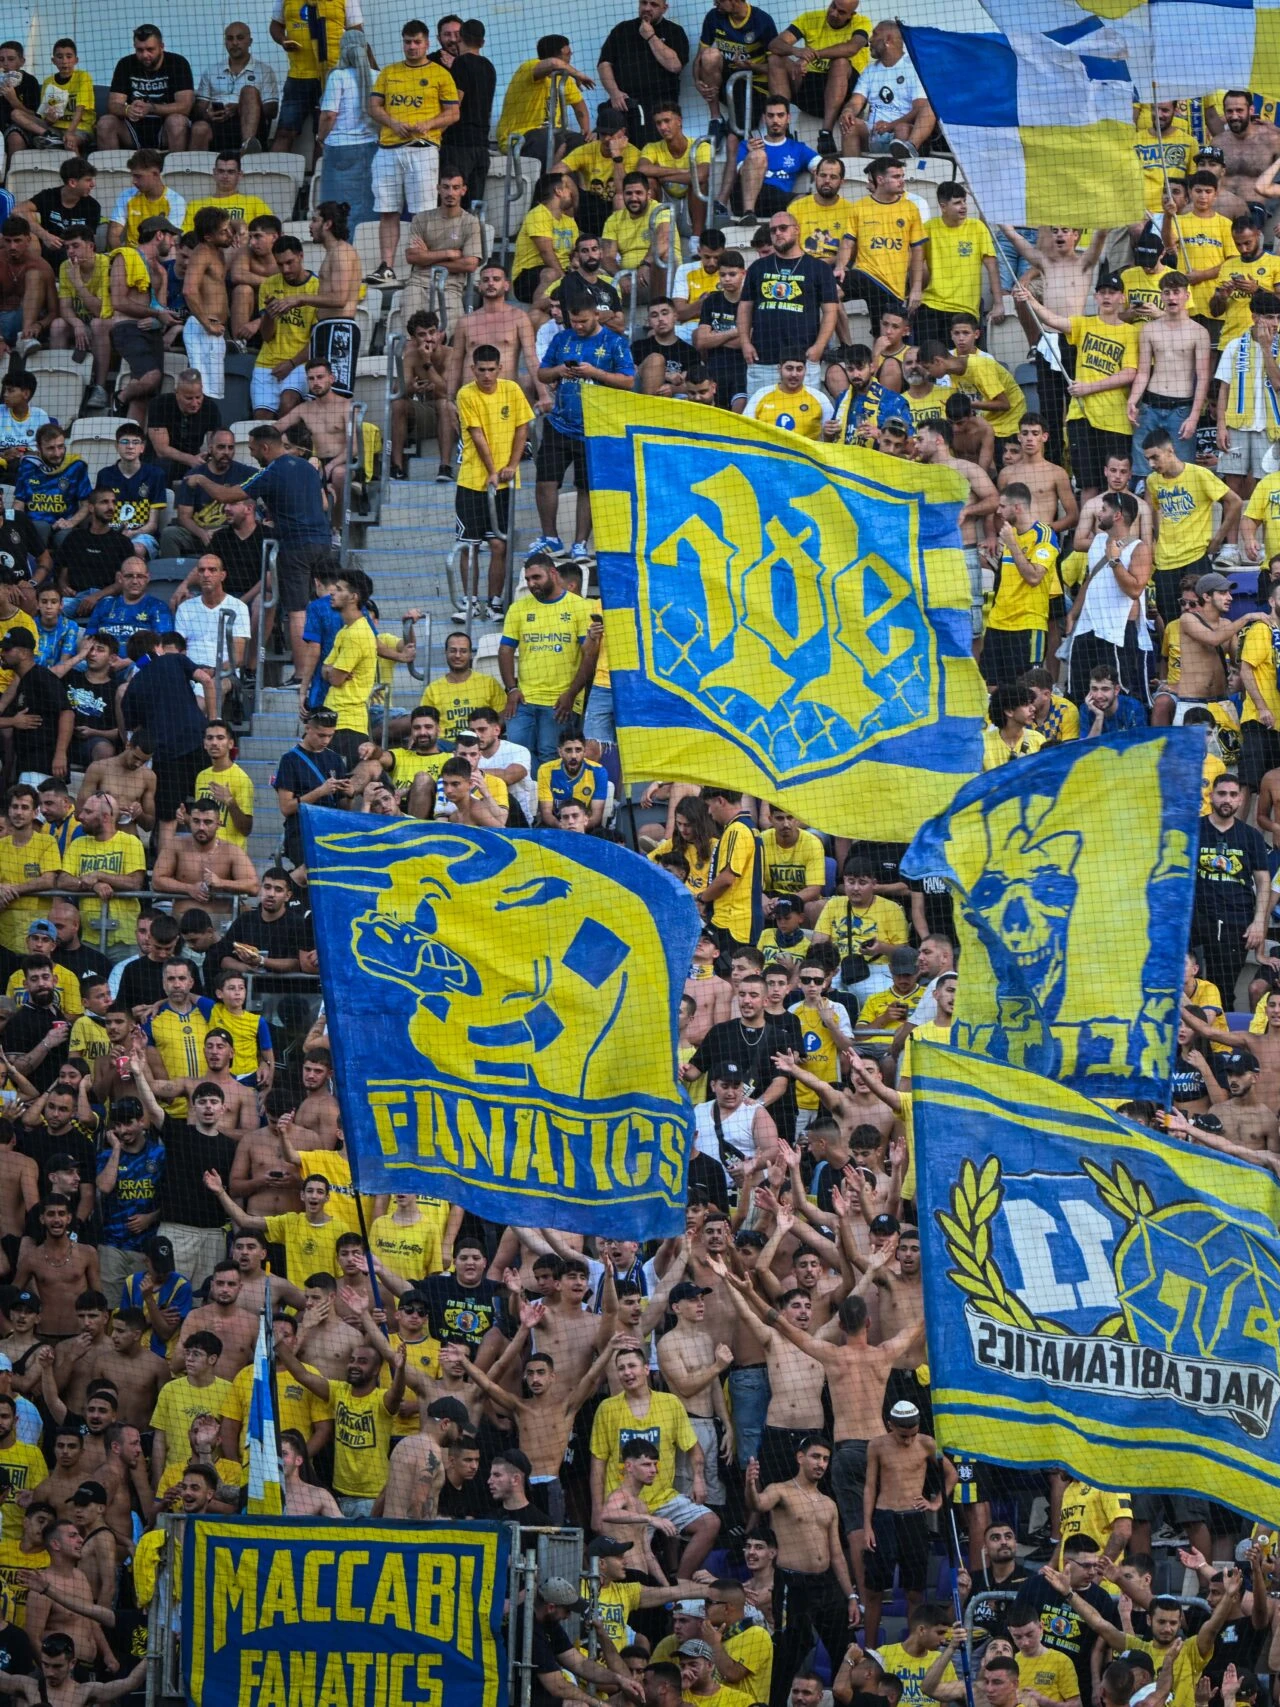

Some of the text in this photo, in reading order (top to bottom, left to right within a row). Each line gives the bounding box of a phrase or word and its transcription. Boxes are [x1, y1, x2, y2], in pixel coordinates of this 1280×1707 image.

[390, 94, 423, 108] 1906
[31, 494, 65, 505] ISRAEL
[28, 503, 68, 514] CANADA
[367, 1090, 686, 1196] FANATICS
[119, 1179, 154, 1190] ISRAEL
[213, 1546, 476, 1661] MACCABI
[236, 1648, 444, 1707] FANATICS
